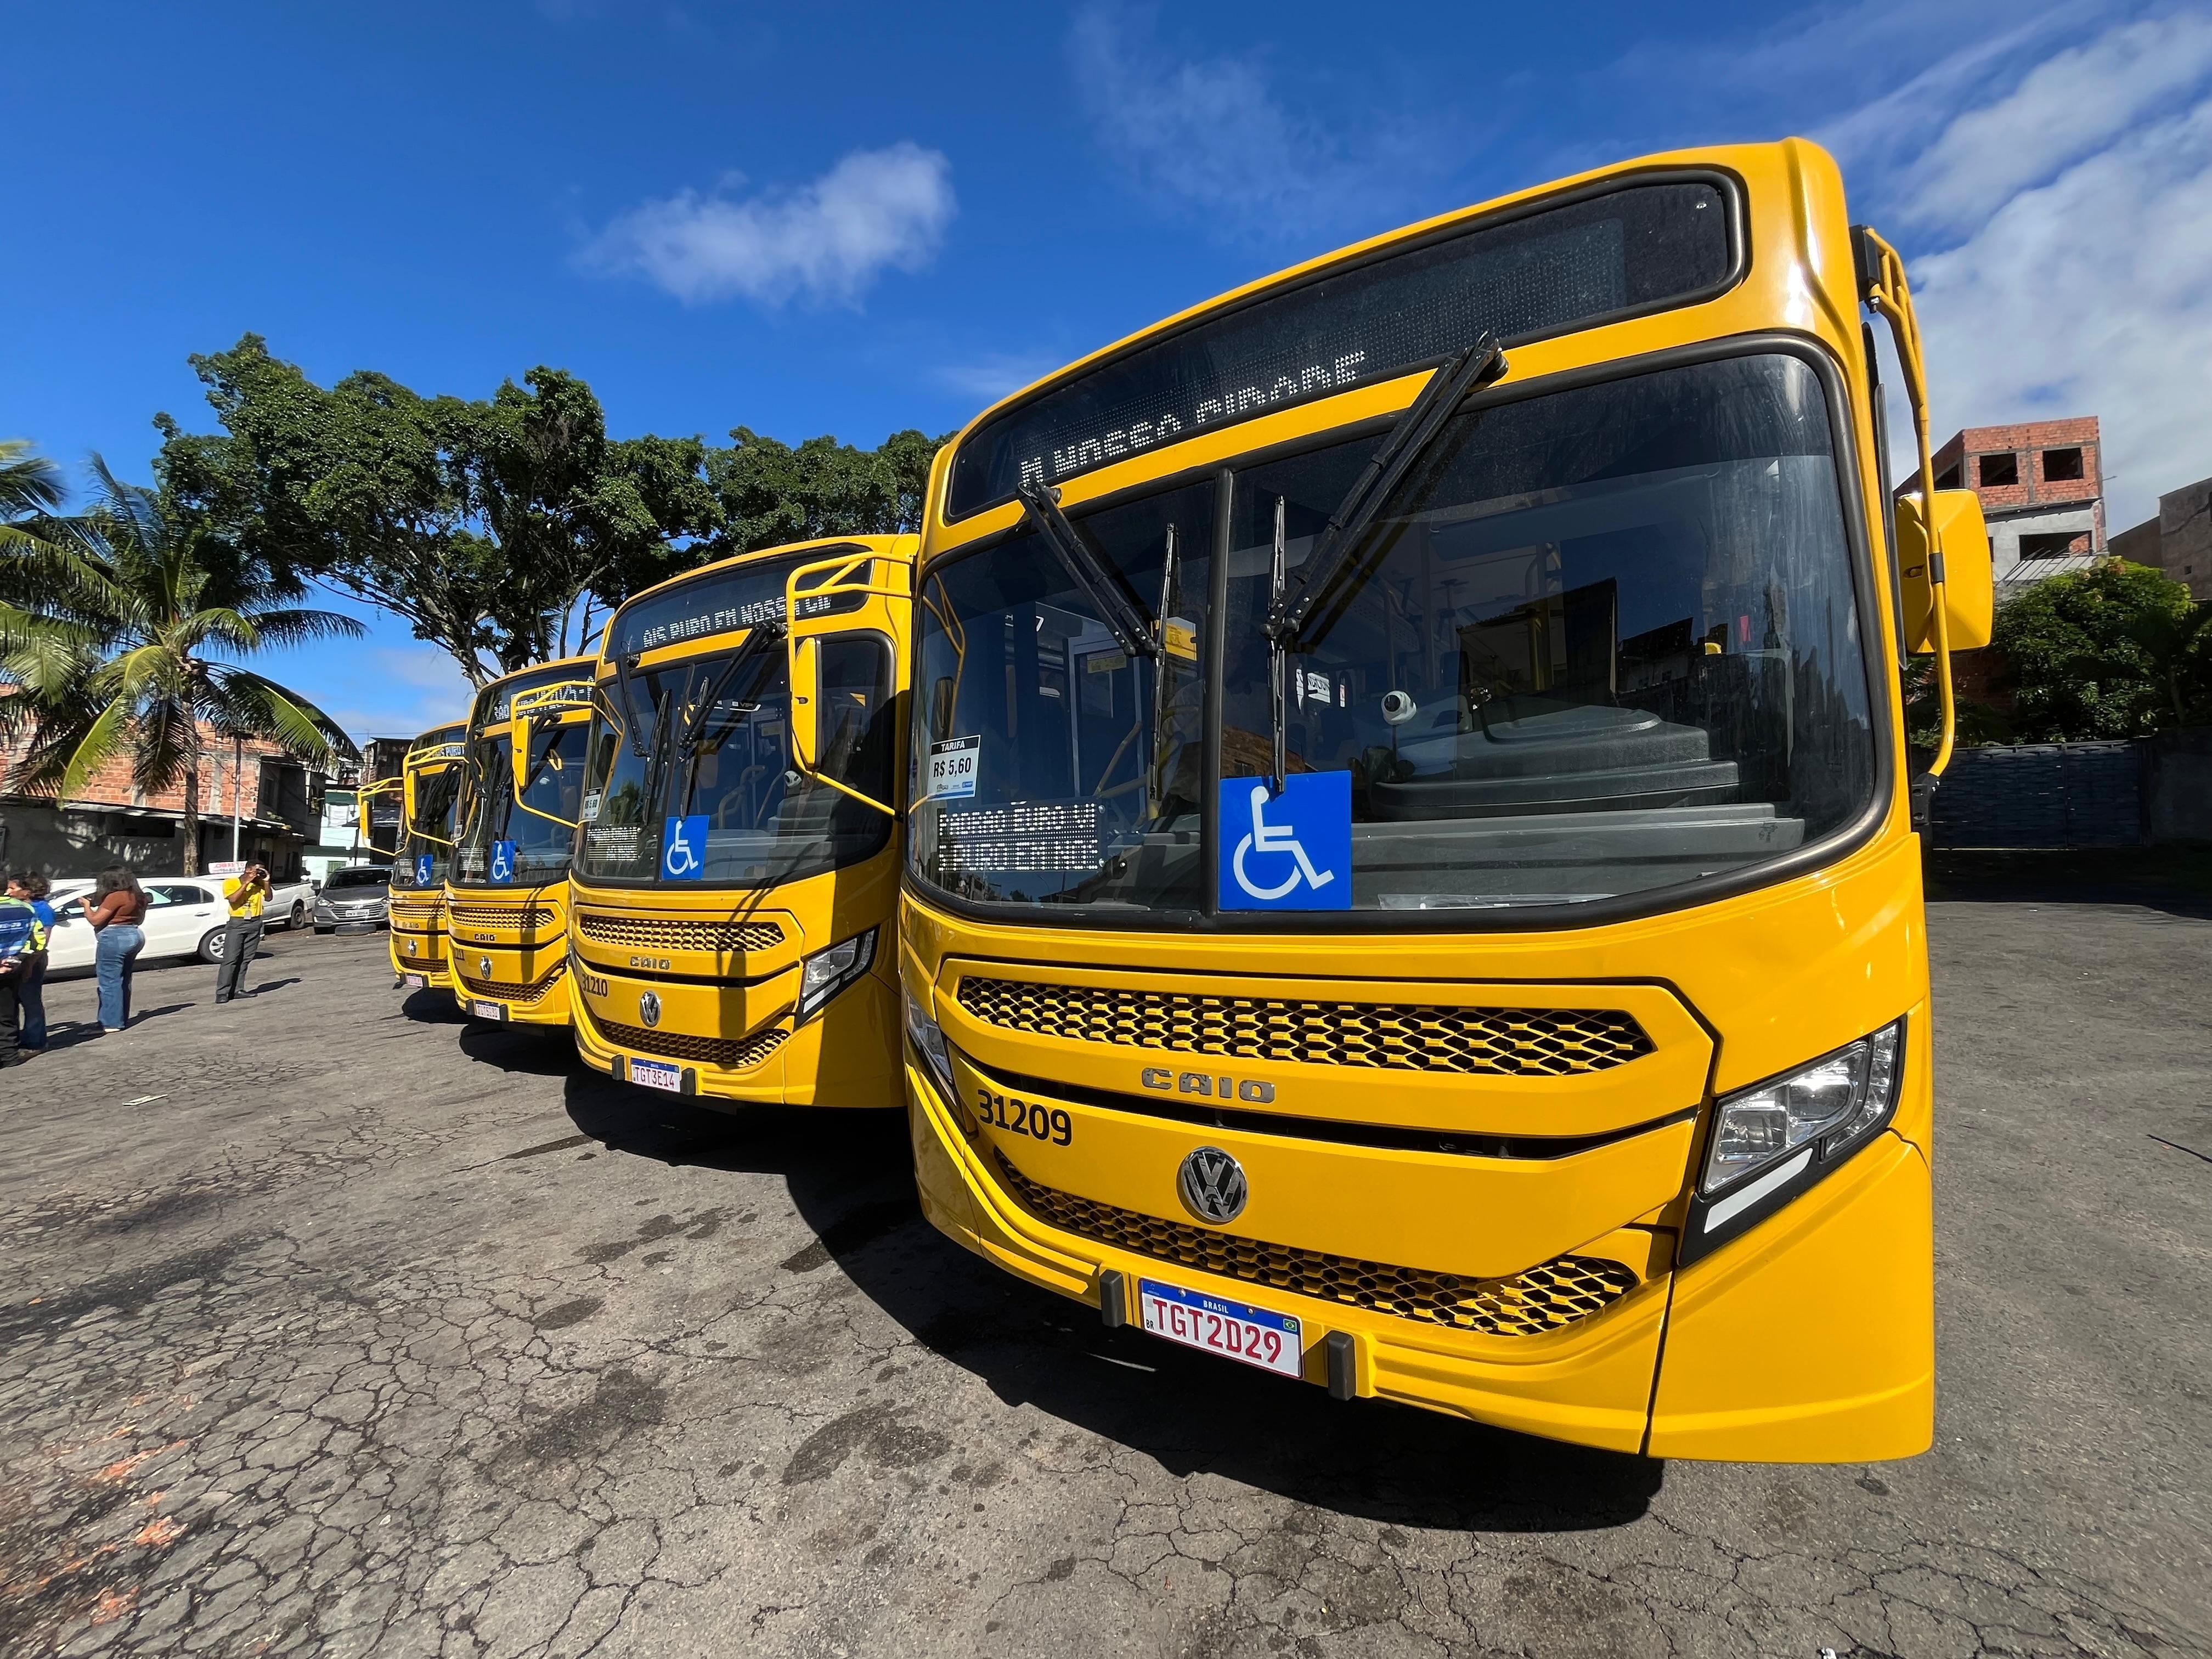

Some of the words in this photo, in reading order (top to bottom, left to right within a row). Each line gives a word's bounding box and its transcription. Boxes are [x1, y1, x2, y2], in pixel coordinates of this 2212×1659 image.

[941, 741, 965, 752] TARIFA
[933, 760, 945, 778] R$
[949, 757, 972, 777] 5,60
[630, 956, 670, 970] CAIO
[635, 1066, 675, 1088] TGT3E14
[1142, 1068, 1276, 1103] CAIO
[977, 1089, 1072, 1147] 31209
[1203, 1300, 1229, 1314] BRASIL
[1146, 1319, 1154, 1330] BR
[1153, 1298, 1282, 1364] TGT2D29
